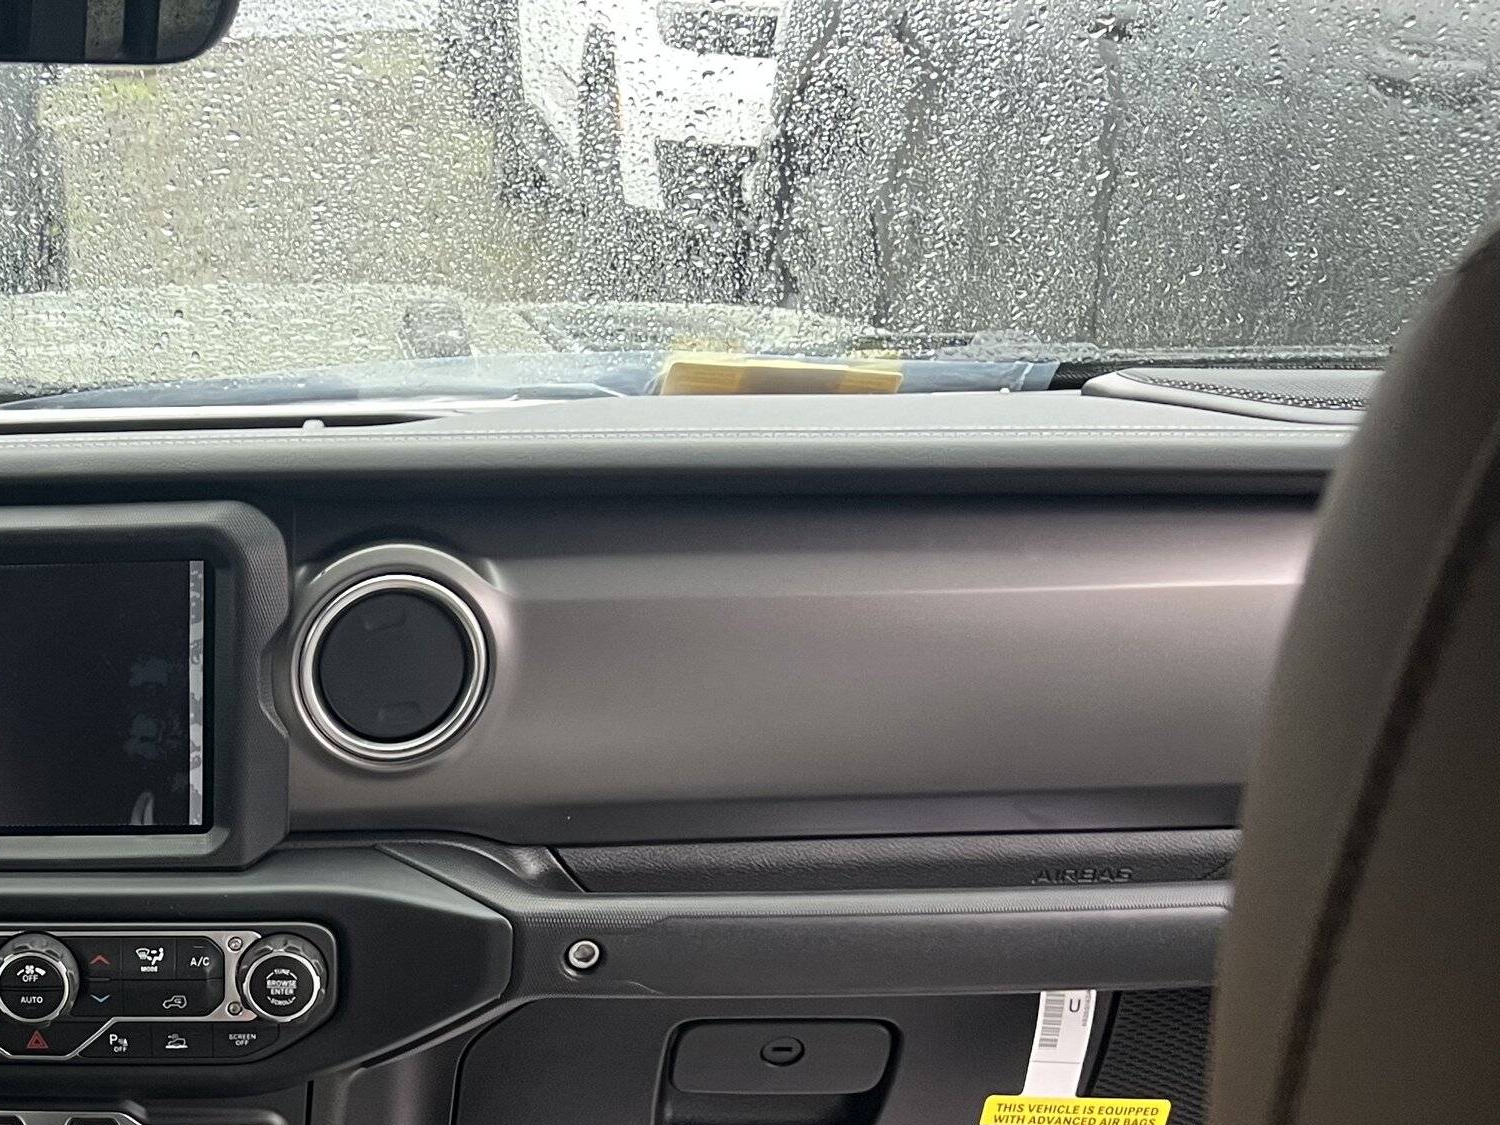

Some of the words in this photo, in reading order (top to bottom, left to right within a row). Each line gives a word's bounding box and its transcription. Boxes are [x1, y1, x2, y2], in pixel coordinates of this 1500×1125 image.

[190, 956, 210, 967] A/C
[22, 974, 39, 983] OFF
[266, 980, 297, 988] BROWSE
[20, 996, 44, 1004] AUTO
[1069, 999, 1081, 1013] U
[228, 1033, 256, 1041] SCREEN
[996, 1103, 1025, 1113] THIS
[1028, 1104, 1081, 1115] VEHICLE
[1083, 1105, 1095, 1115] IS
[1097, 1106, 1159, 1116] EQUIPPED
[993, 1114, 1026, 1124] WITH
[1027, 1115, 1097, 1125] ADVANCED
